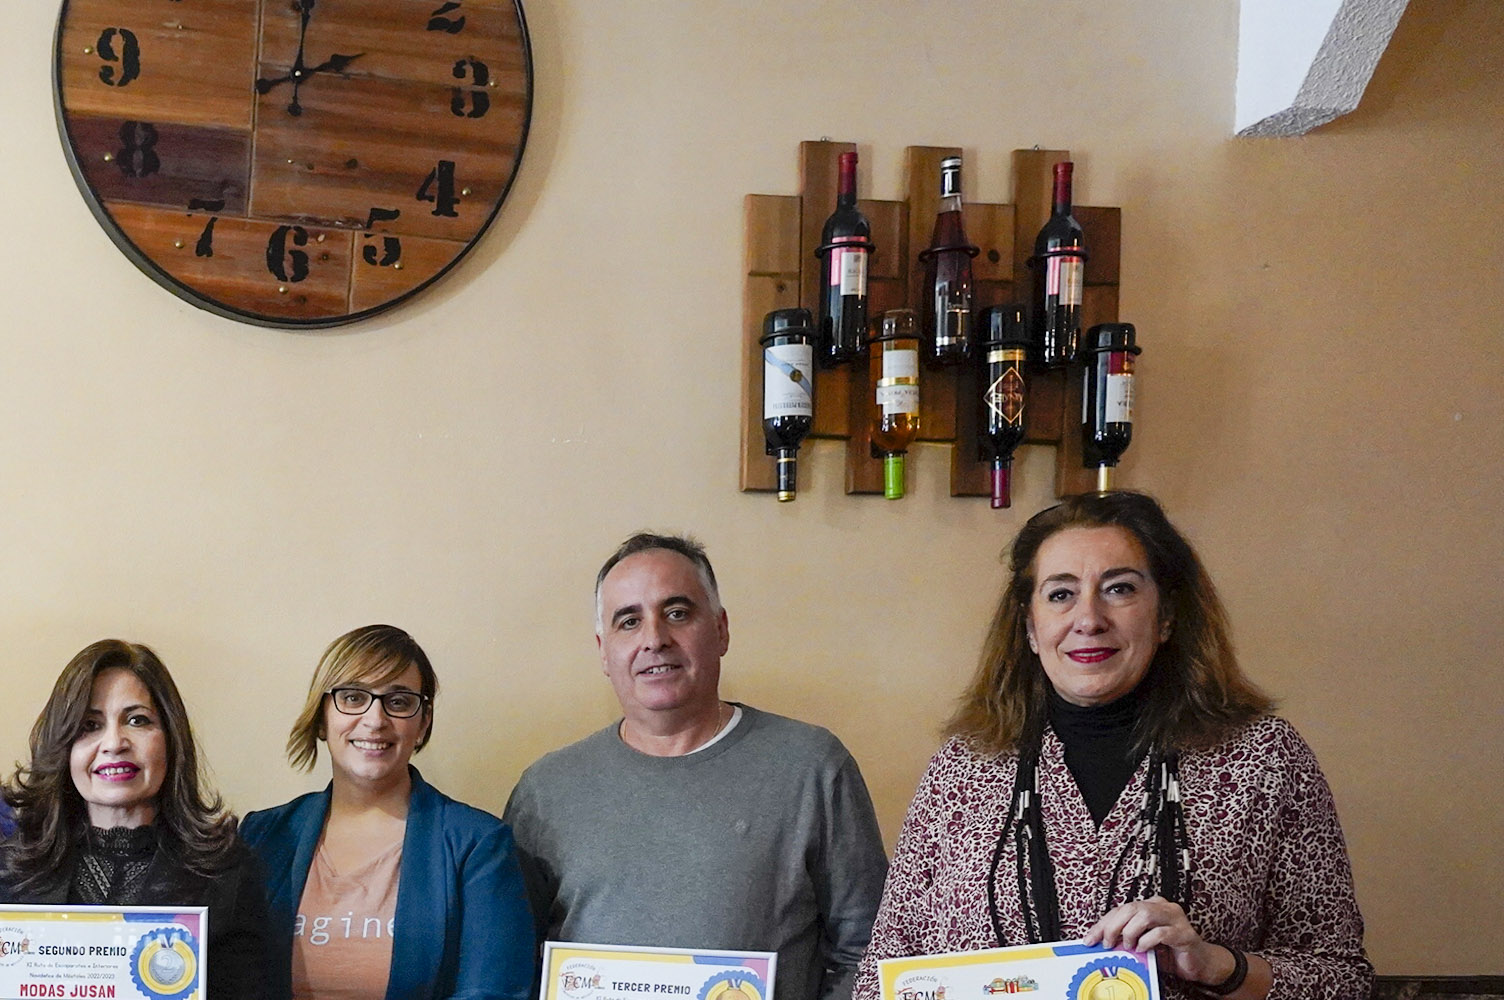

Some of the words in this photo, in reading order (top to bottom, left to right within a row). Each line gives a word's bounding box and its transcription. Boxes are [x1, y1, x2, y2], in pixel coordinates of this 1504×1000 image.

[97, 27, 141, 88] 9
[450, 55, 490, 119] 3
[115, 120, 161, 179] 8
[415, 160, 461, 218] 4
[187, 198, 227, 258] 7
[266, 224, 310, 283] 6
[363, 207, 403, 267] 5
[38, 945, 85, 956] SEGUNDO
[89, 945, 126, 956] PREMIO
[901, 974, 937, 986] FEDERACIÓN
[20, 983, 64, 997] MODAS
[70, 983, 114, 998] JUSAN
[611, 980, 650, 992] TERCER
[653, 983, 691, 995] PREMIO
